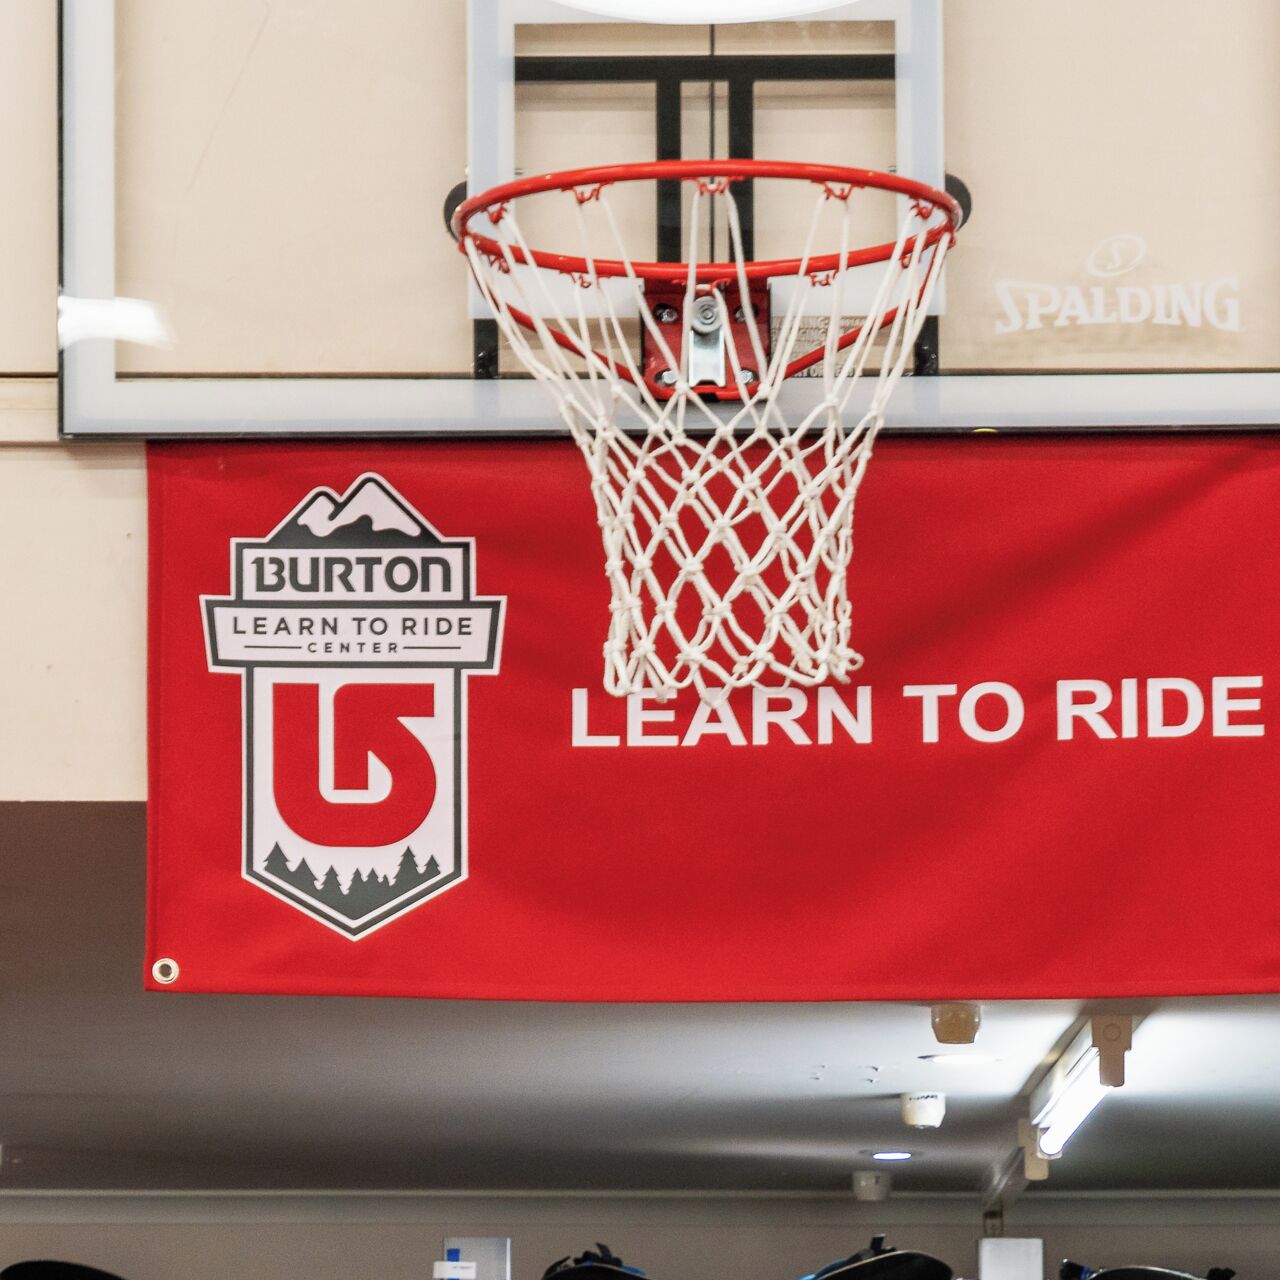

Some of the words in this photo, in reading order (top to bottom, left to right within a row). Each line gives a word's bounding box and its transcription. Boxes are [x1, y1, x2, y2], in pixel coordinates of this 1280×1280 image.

[993, 276, 1240, 335] SPALDING
[251, 556, 452, 593] BURTON
[232, 616, 340, 637] LEARN
[351, 616, 389, 637] TO
[400, 616, 473, 637] RIDE
[306, 641, 400, 654] CENTER
[570, 684, 874, 748] LEARN
[902, 682, 1025, 745] TO
[1056, 674, 1267, 742] RIDE
